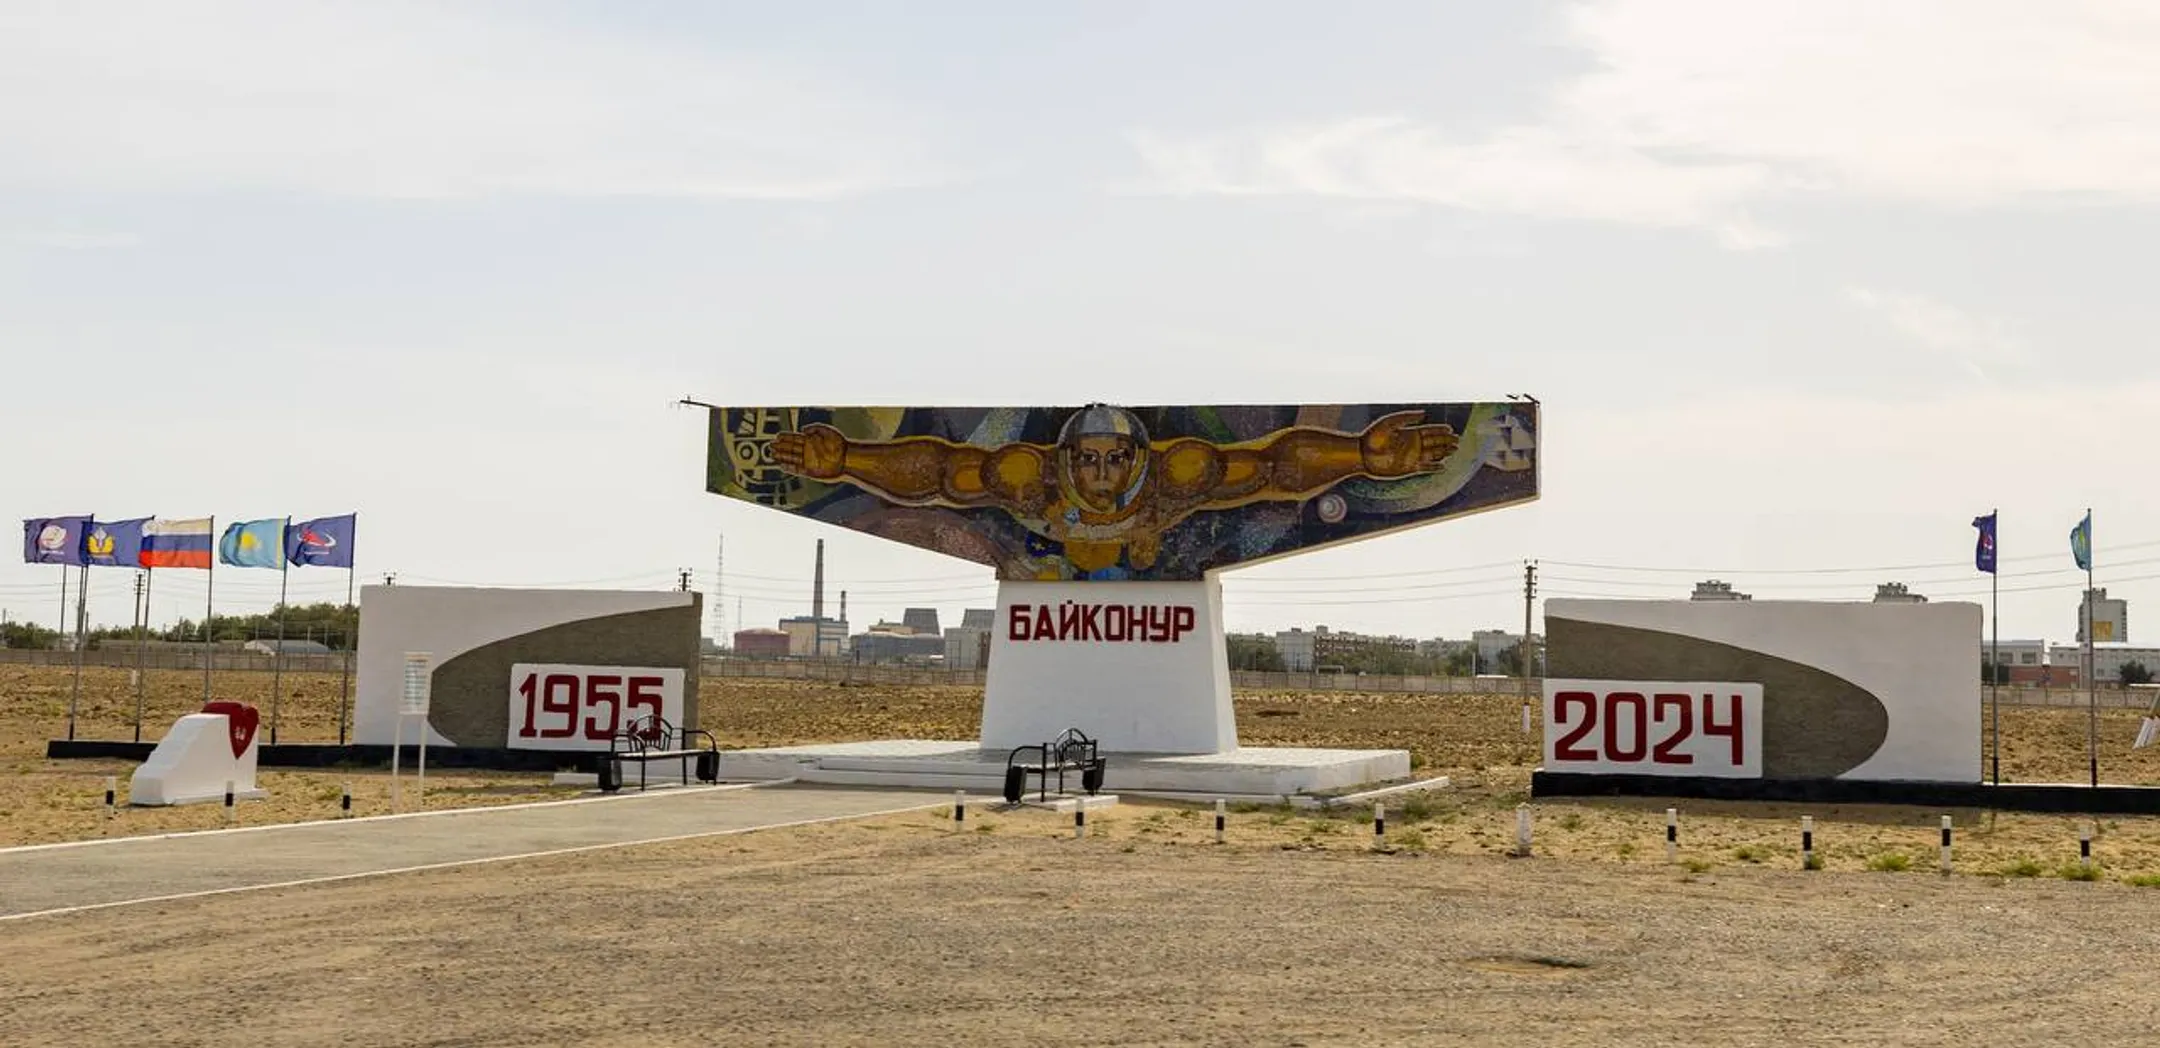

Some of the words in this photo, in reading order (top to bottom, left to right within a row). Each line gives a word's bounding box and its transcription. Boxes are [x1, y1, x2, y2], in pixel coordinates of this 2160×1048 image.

[1009, 600, 1195, 642] БАЙКОНУР
[519, 673, 664, 740] 1955
[1554, 692, 1743, 765] 2024
